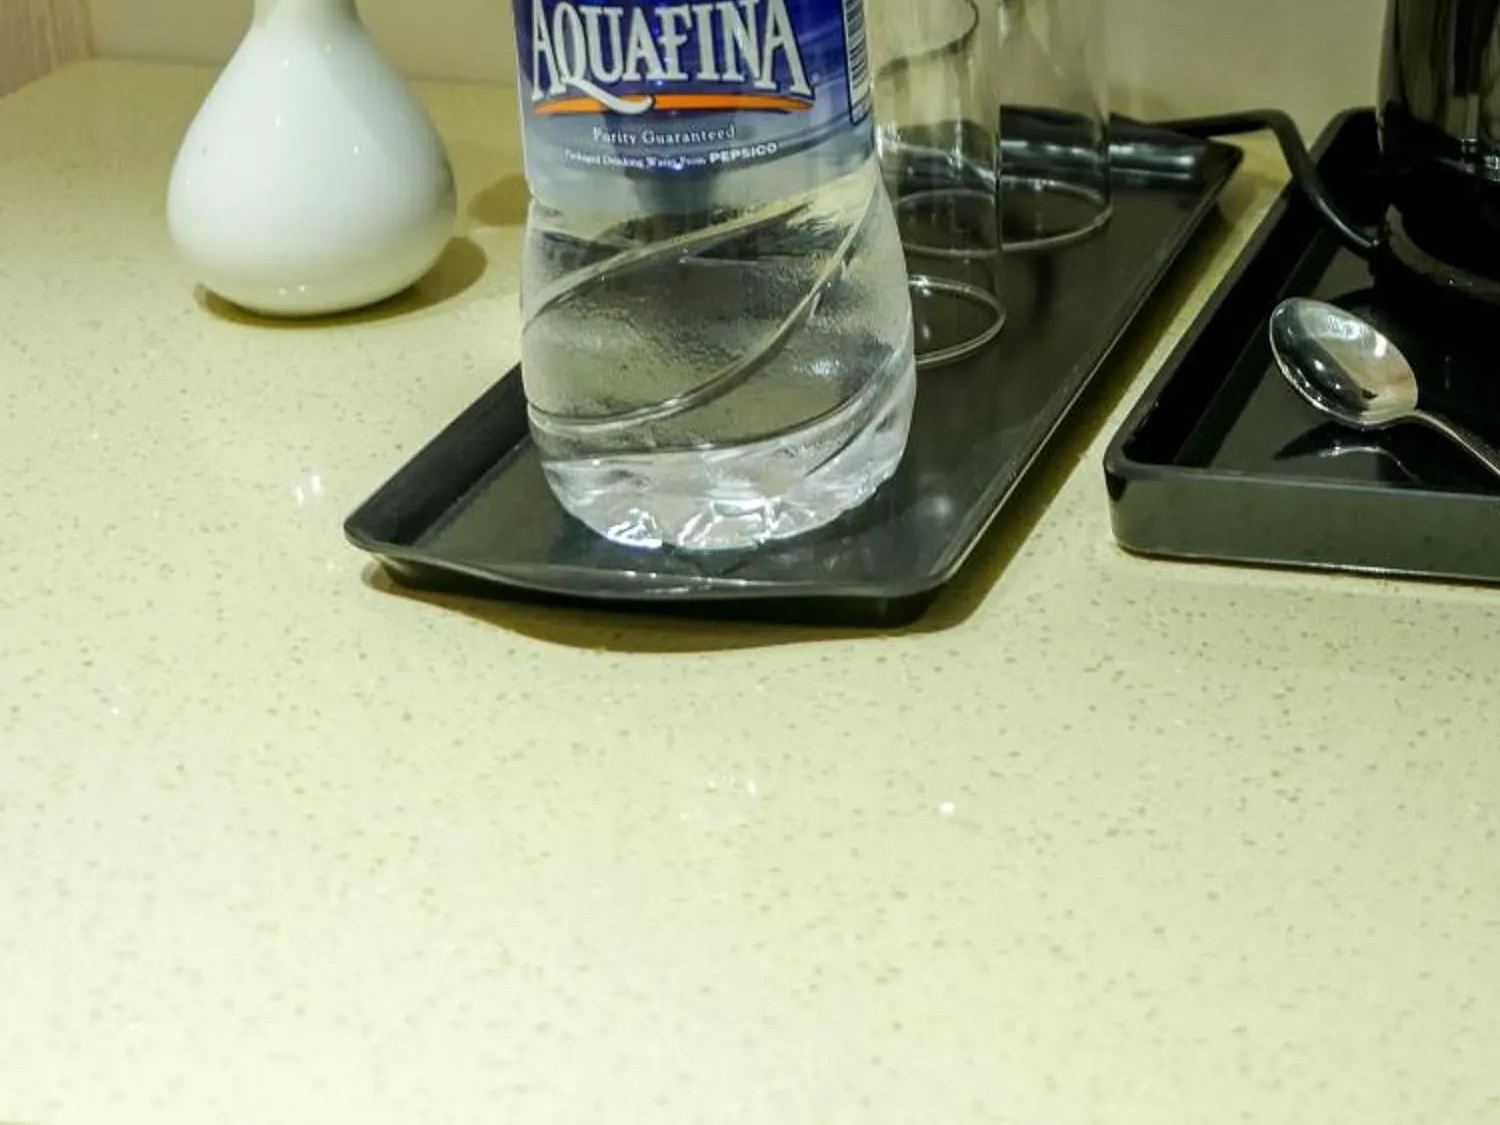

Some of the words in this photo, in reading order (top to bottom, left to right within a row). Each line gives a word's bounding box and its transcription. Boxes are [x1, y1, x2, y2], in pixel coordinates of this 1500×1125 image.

[592, 126, 637, 146] Purity
[641, 124, 736, 145] Guaranteed
[709, 141, 778, 164] PEPSICO
